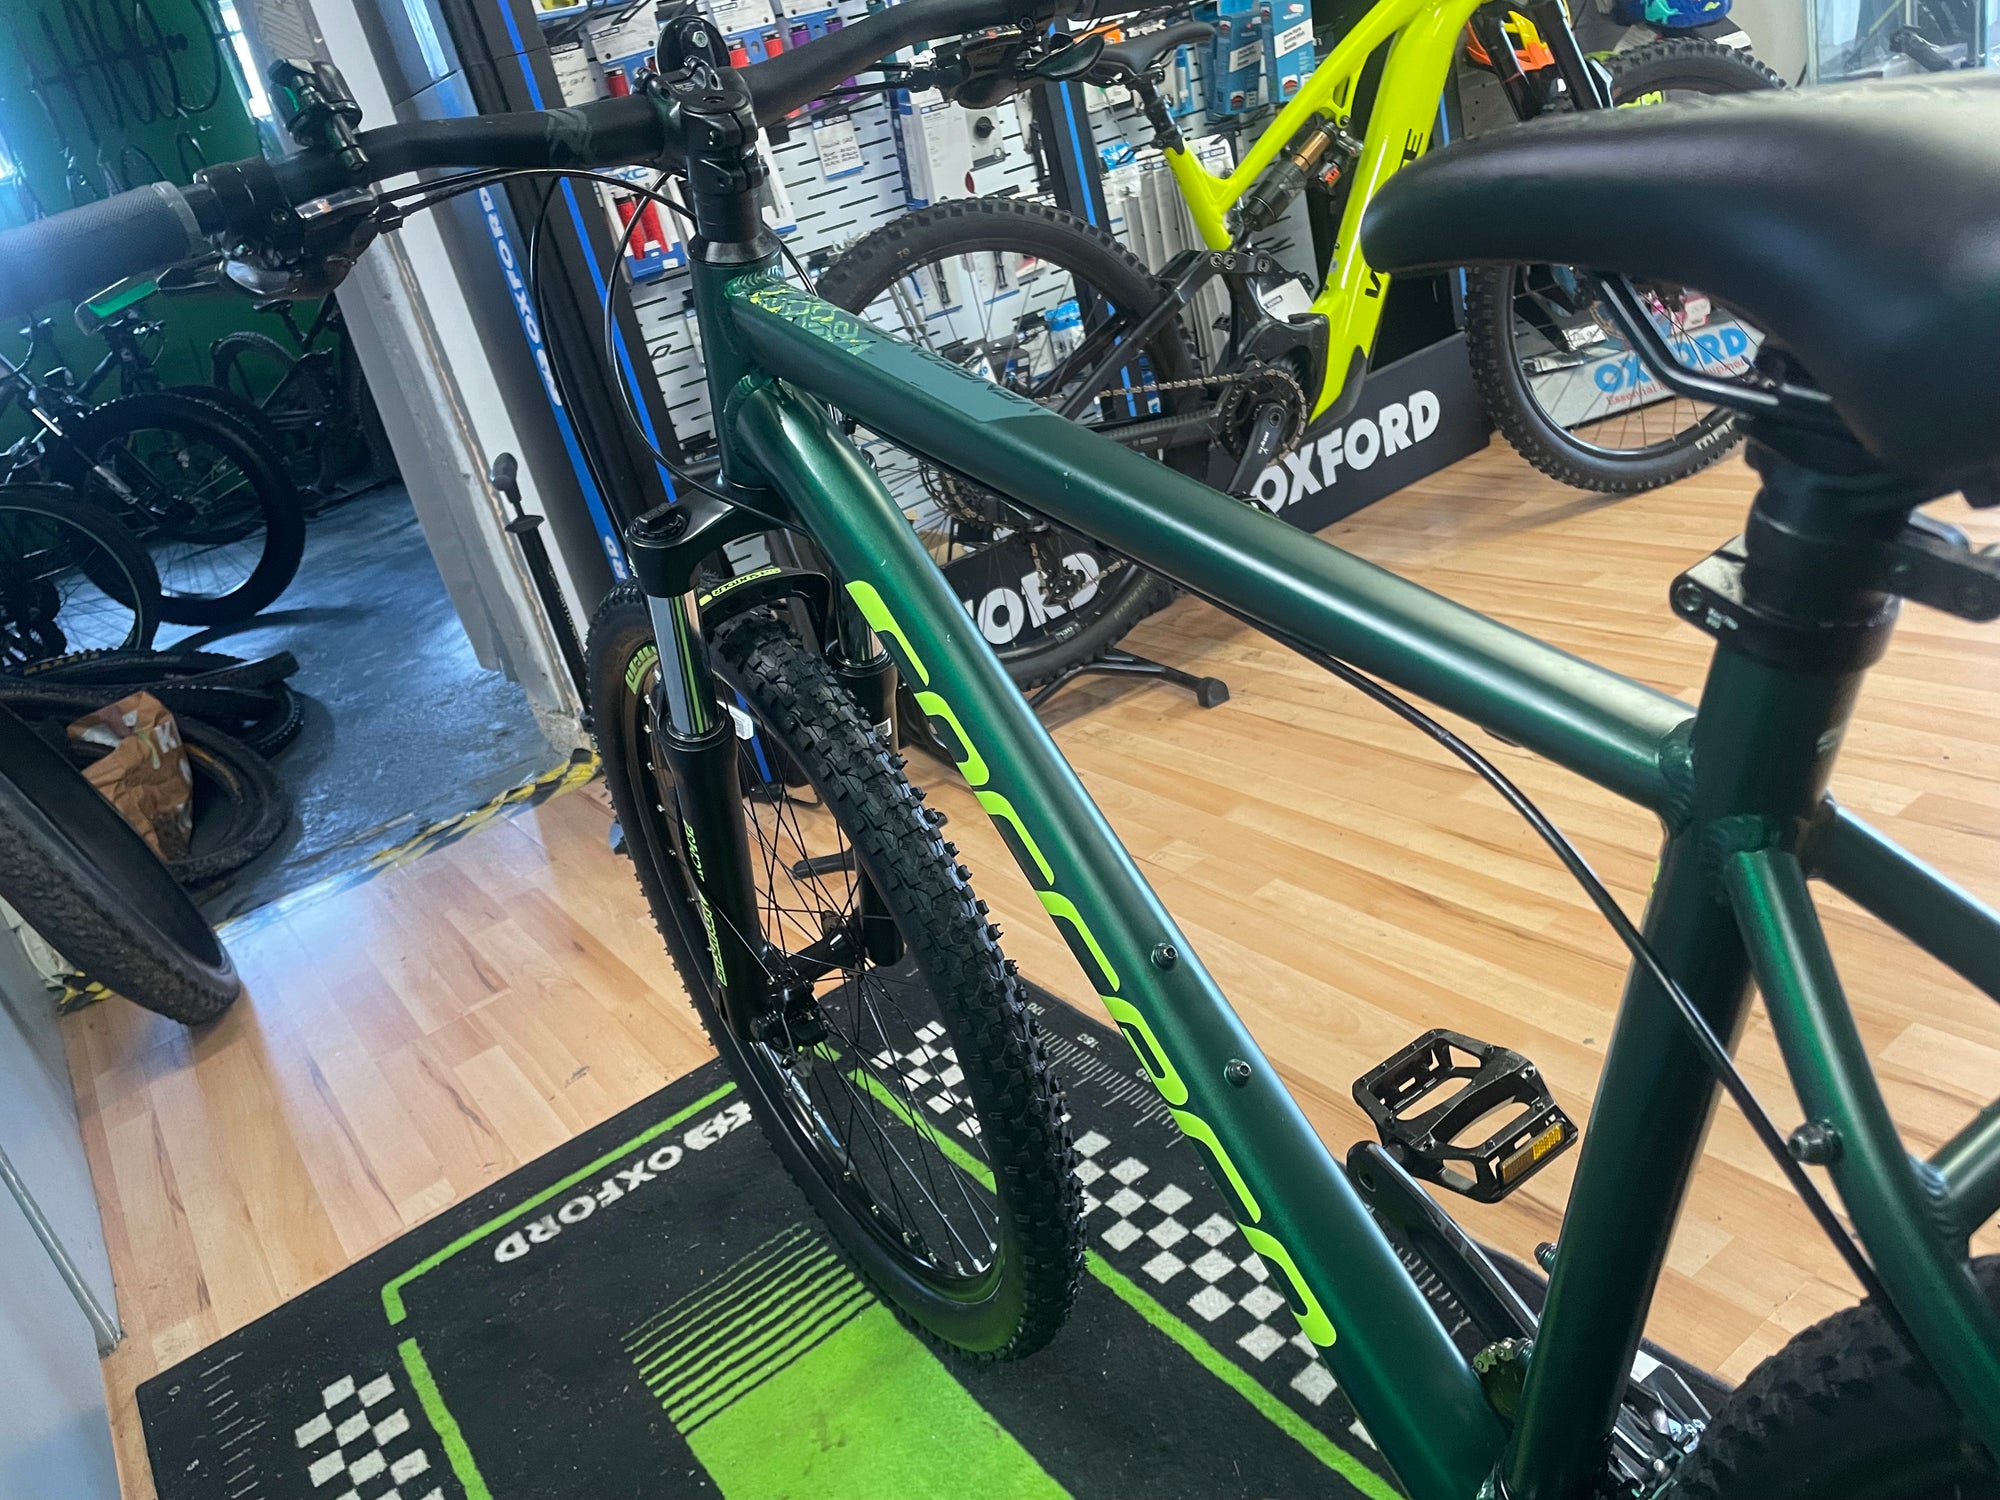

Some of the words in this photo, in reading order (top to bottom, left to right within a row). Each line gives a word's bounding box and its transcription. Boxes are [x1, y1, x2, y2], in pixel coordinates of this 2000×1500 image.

[478, 187, 541, 345] OXFORD
[1594, 327, 1748, 393] OXORD
[1250, 390, 1440, 513] OXFORD
[963, 553, 1100, 645] ORD
[493, 1145, 683, 1263] OXFORD
